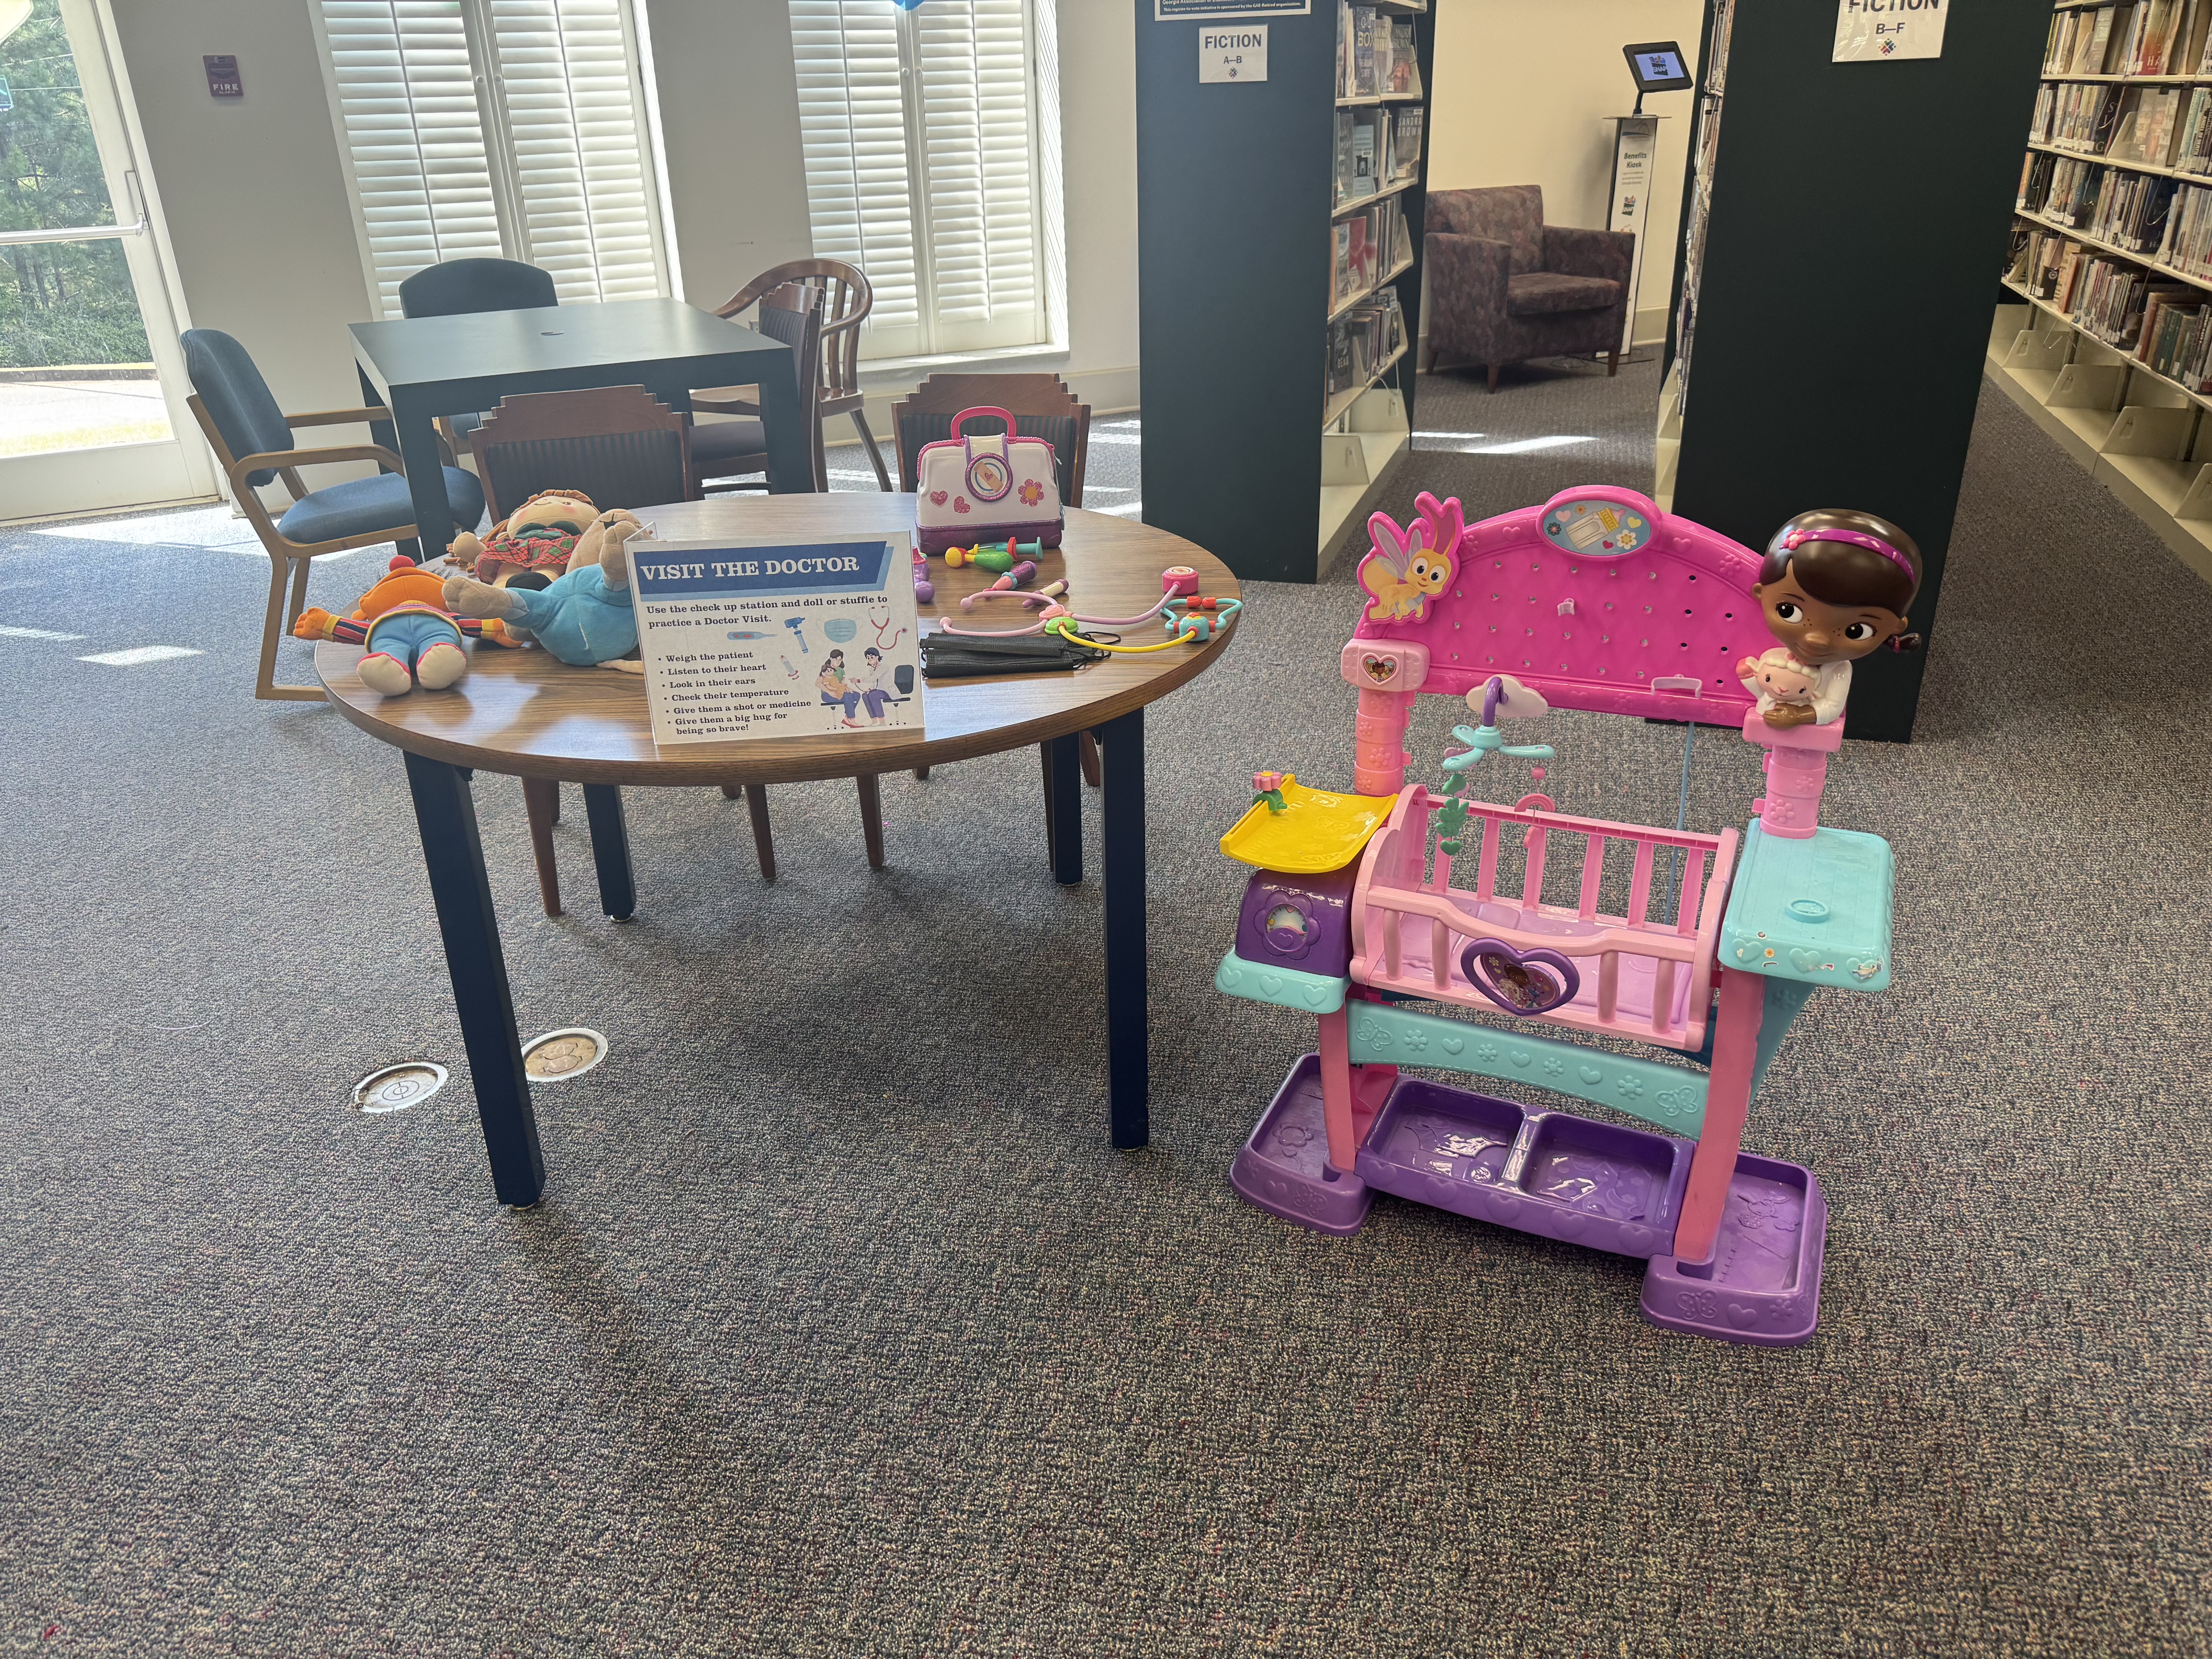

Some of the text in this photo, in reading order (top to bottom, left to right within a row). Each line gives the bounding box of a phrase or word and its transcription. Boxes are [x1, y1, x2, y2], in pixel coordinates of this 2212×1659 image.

[1205, 34, 1262, 49] FICTION
[1358, 31, 1375, 46] BOX
[1398, 117, 1422, 127] SANDRA
[1397, 127, 1420, 137] BROWN
[641, 556, 860, 580] VISIT THE DOCTOR
[690, 603, 721, 612] check
[740, 601, 778, 610] station
[781, 599, 801, 608] and
[804, 598, 823, 606] doll
[840, 596, 874, 605] stuffie
[648, 619, 692, 629] practice
[704, 617, 739, 625] Doctor
[742, 615, 771, 623] Visit.
[666, 654, 697, 663] Weigh
[718, 651, 753, 661] patient
[740, 663, 767, 672] heart
[730, 689, 789, 699] temperature
[769, 700, 811, 708] medicine
[734, 714, 750, 723] big
[719, 724, 749, 732] brave!
